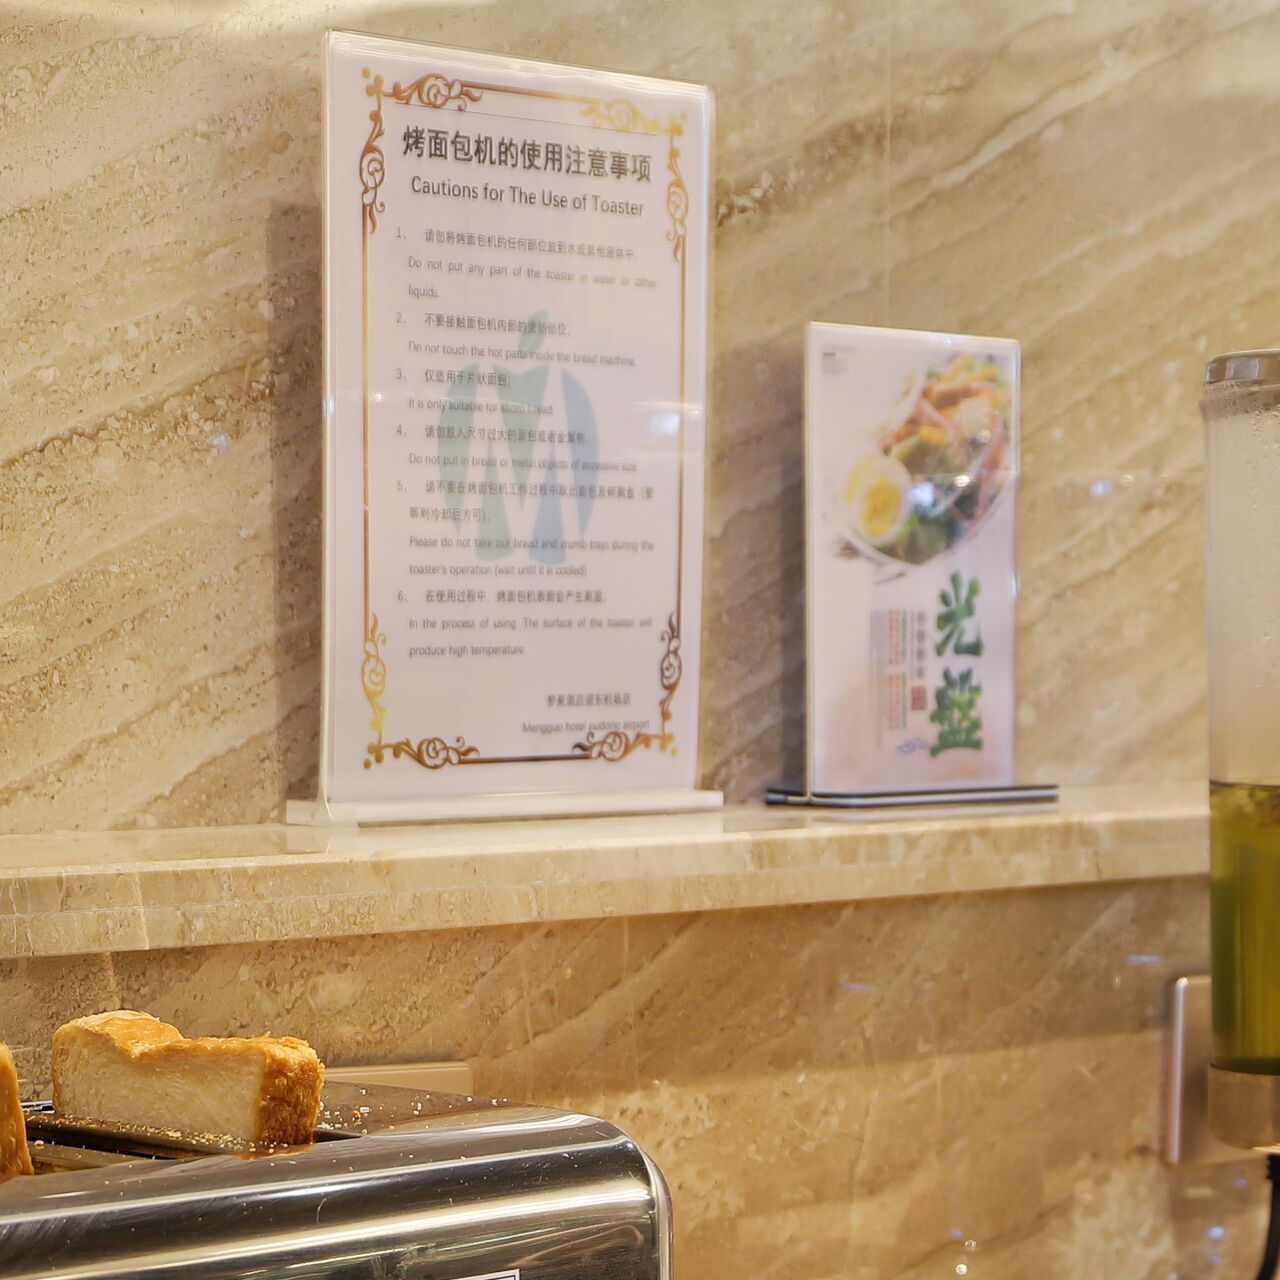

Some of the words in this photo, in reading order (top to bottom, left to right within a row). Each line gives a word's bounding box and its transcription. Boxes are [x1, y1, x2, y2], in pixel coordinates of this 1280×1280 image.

[403, 125, 651, 183] 烤面包机的使用注意事项
[411, 175, 478, 199] Cautions
[483, 182, 504, 202] for
[509, 185, 537, 205] The
[542, 190, 568, 208] Use
[572, 192, 588, 210] of
[592, 195, 645, 216] Toaster
[408, 255, 422, 268] Do
[427, 259, 442, 270] not
[448, 261, 463, 274] put
[468, 263, 485, 276] any
[489, 265, 508, 278] part
[513, 266, 522, 277] of
[527, 267, 541, 279] the
[546, 269, 575, 281] toaster
[408, 340, 422, 352] Do
[424, 342, 440, 354] not
[442, 344, 469, 357] touch
[471, 345, 485, 357] the
[488, 346, 503, 358] hot
[557, 352, 571, 362] the
[573, 352, 598, 364] bread
[409, 398, 415, 409] It
[417, 398, 425, 409] is
[427, 399, 445, 413] only
[449, 400, 483, 412] suitable
[486, 402, 497, 412] for
[409, 452, 423, 464] Do
[425, 454, 440, 465] not
[443, 455, 458, 467] put
[461, 456, 469, 466] in
[472, 456, 498, 467] bread
[409, 536, 438, 548] Please
[441, 537, 453, 547] do
[456, 537, 472, 547] not
[474, 538, 492, 548] take
[495, 539, 511, 549] out
[513, 538, 538, 549] bread
[540, 539, 558, 549] and
[449, 564, 492, 578] operation
[409, 618, 418, 629] In
[422, 617, 437, 629] the
[442, 619, 476, 631] process
[480, 617, 490, 629] of
[523, 617, 539, 628] The
[543, 618, 573, 629] surface
[577, 617, 586, 628] of
[409, 645, 446, 658] produce
[448, 645, 469, 657] high
[522, 721, 563, 735] Mengguo
[565, 721, 586, 732] hotel
